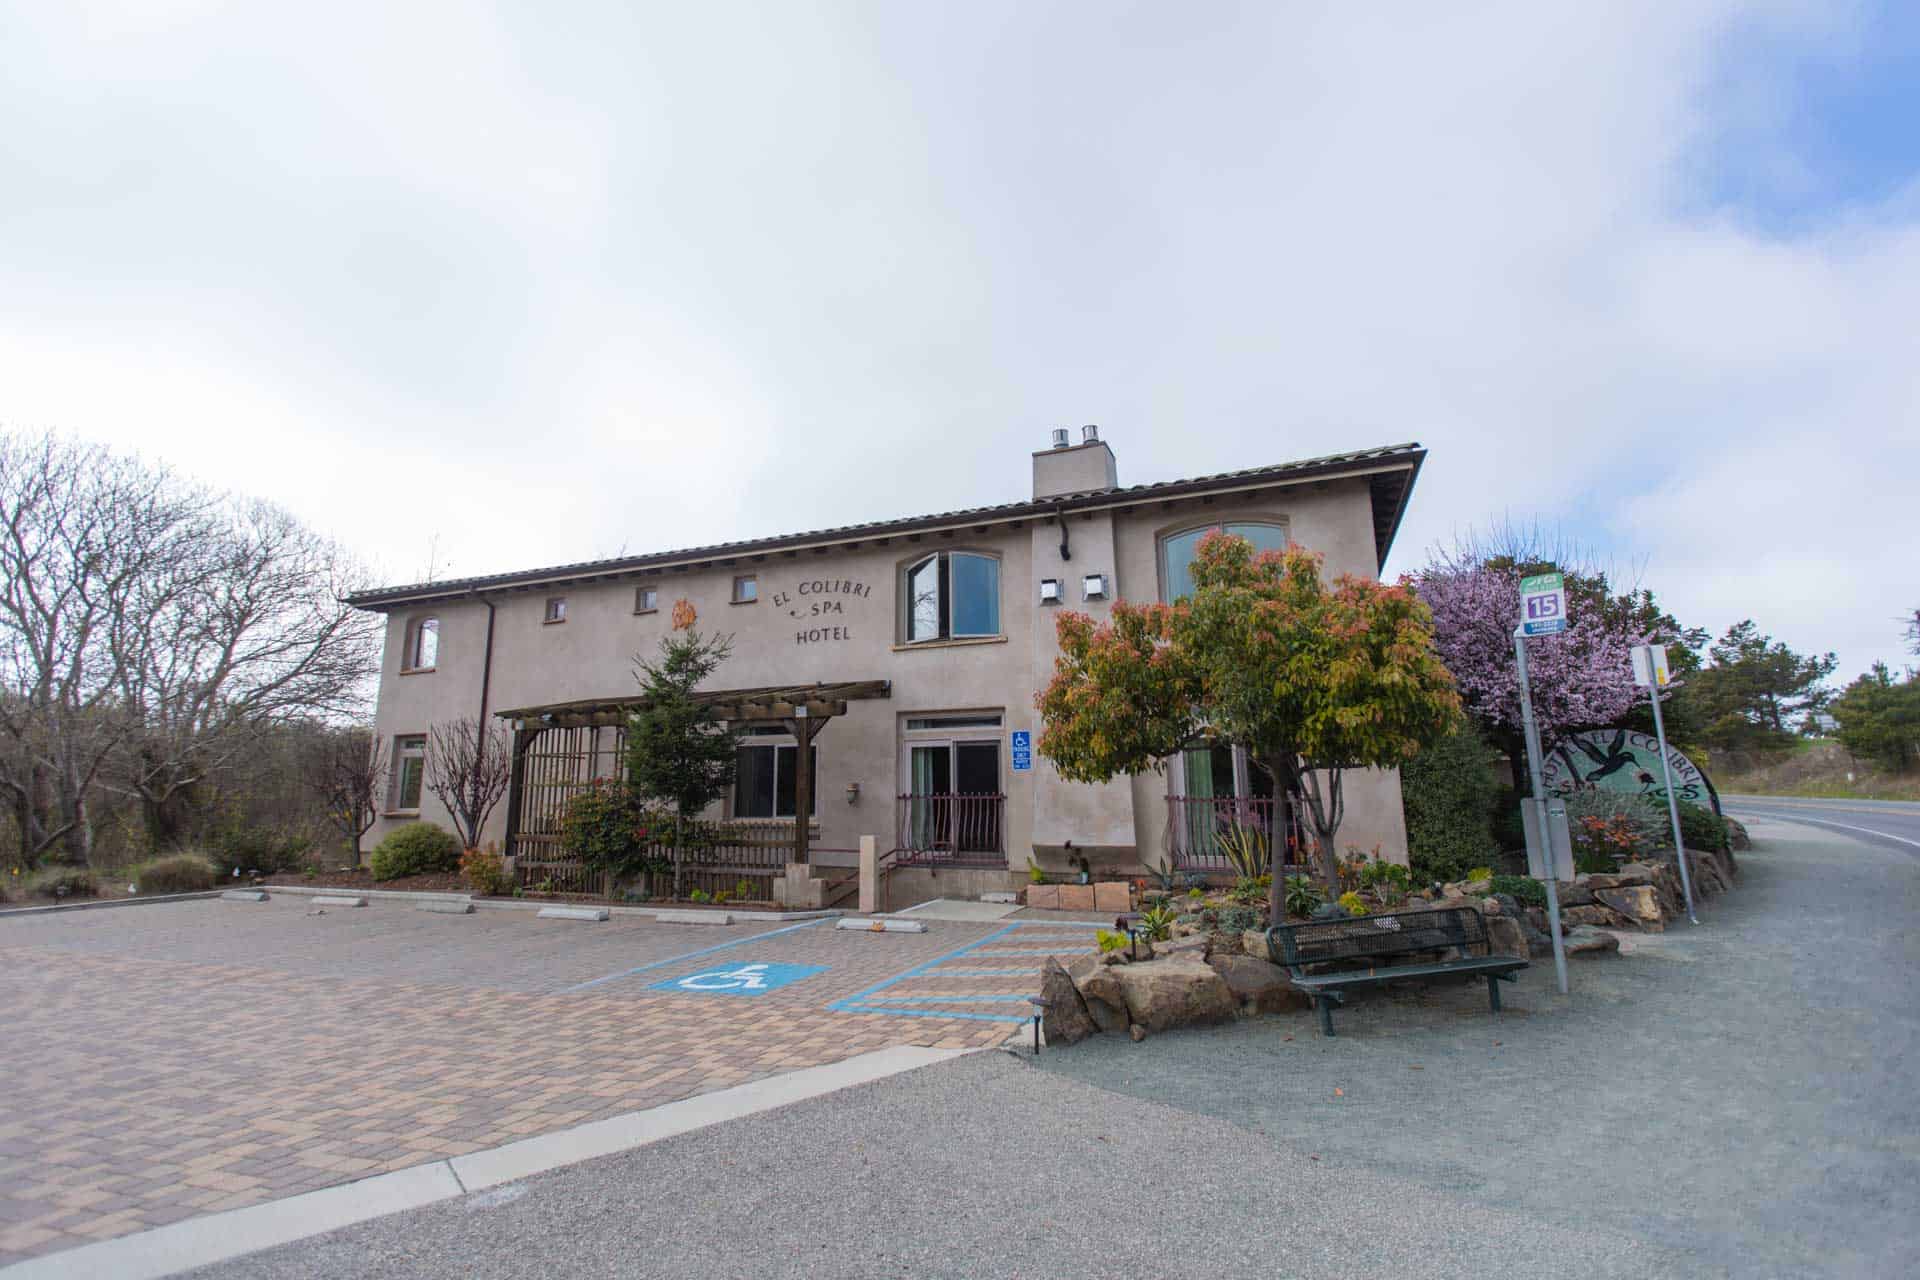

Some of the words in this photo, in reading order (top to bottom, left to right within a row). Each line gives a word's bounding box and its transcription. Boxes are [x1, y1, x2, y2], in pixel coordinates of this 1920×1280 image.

[773, 592, 791, 607] EL
[799, 580, 871, 598] COLIBRI
[811, 601, 842, 616] SPA
[1530, 596, 1557, 617] 15
[797, 626, 850, 644] HOTEL
[1542, 742, 1579, 788] HOTL
[1631, 733, 1700, 783] COIBRI
